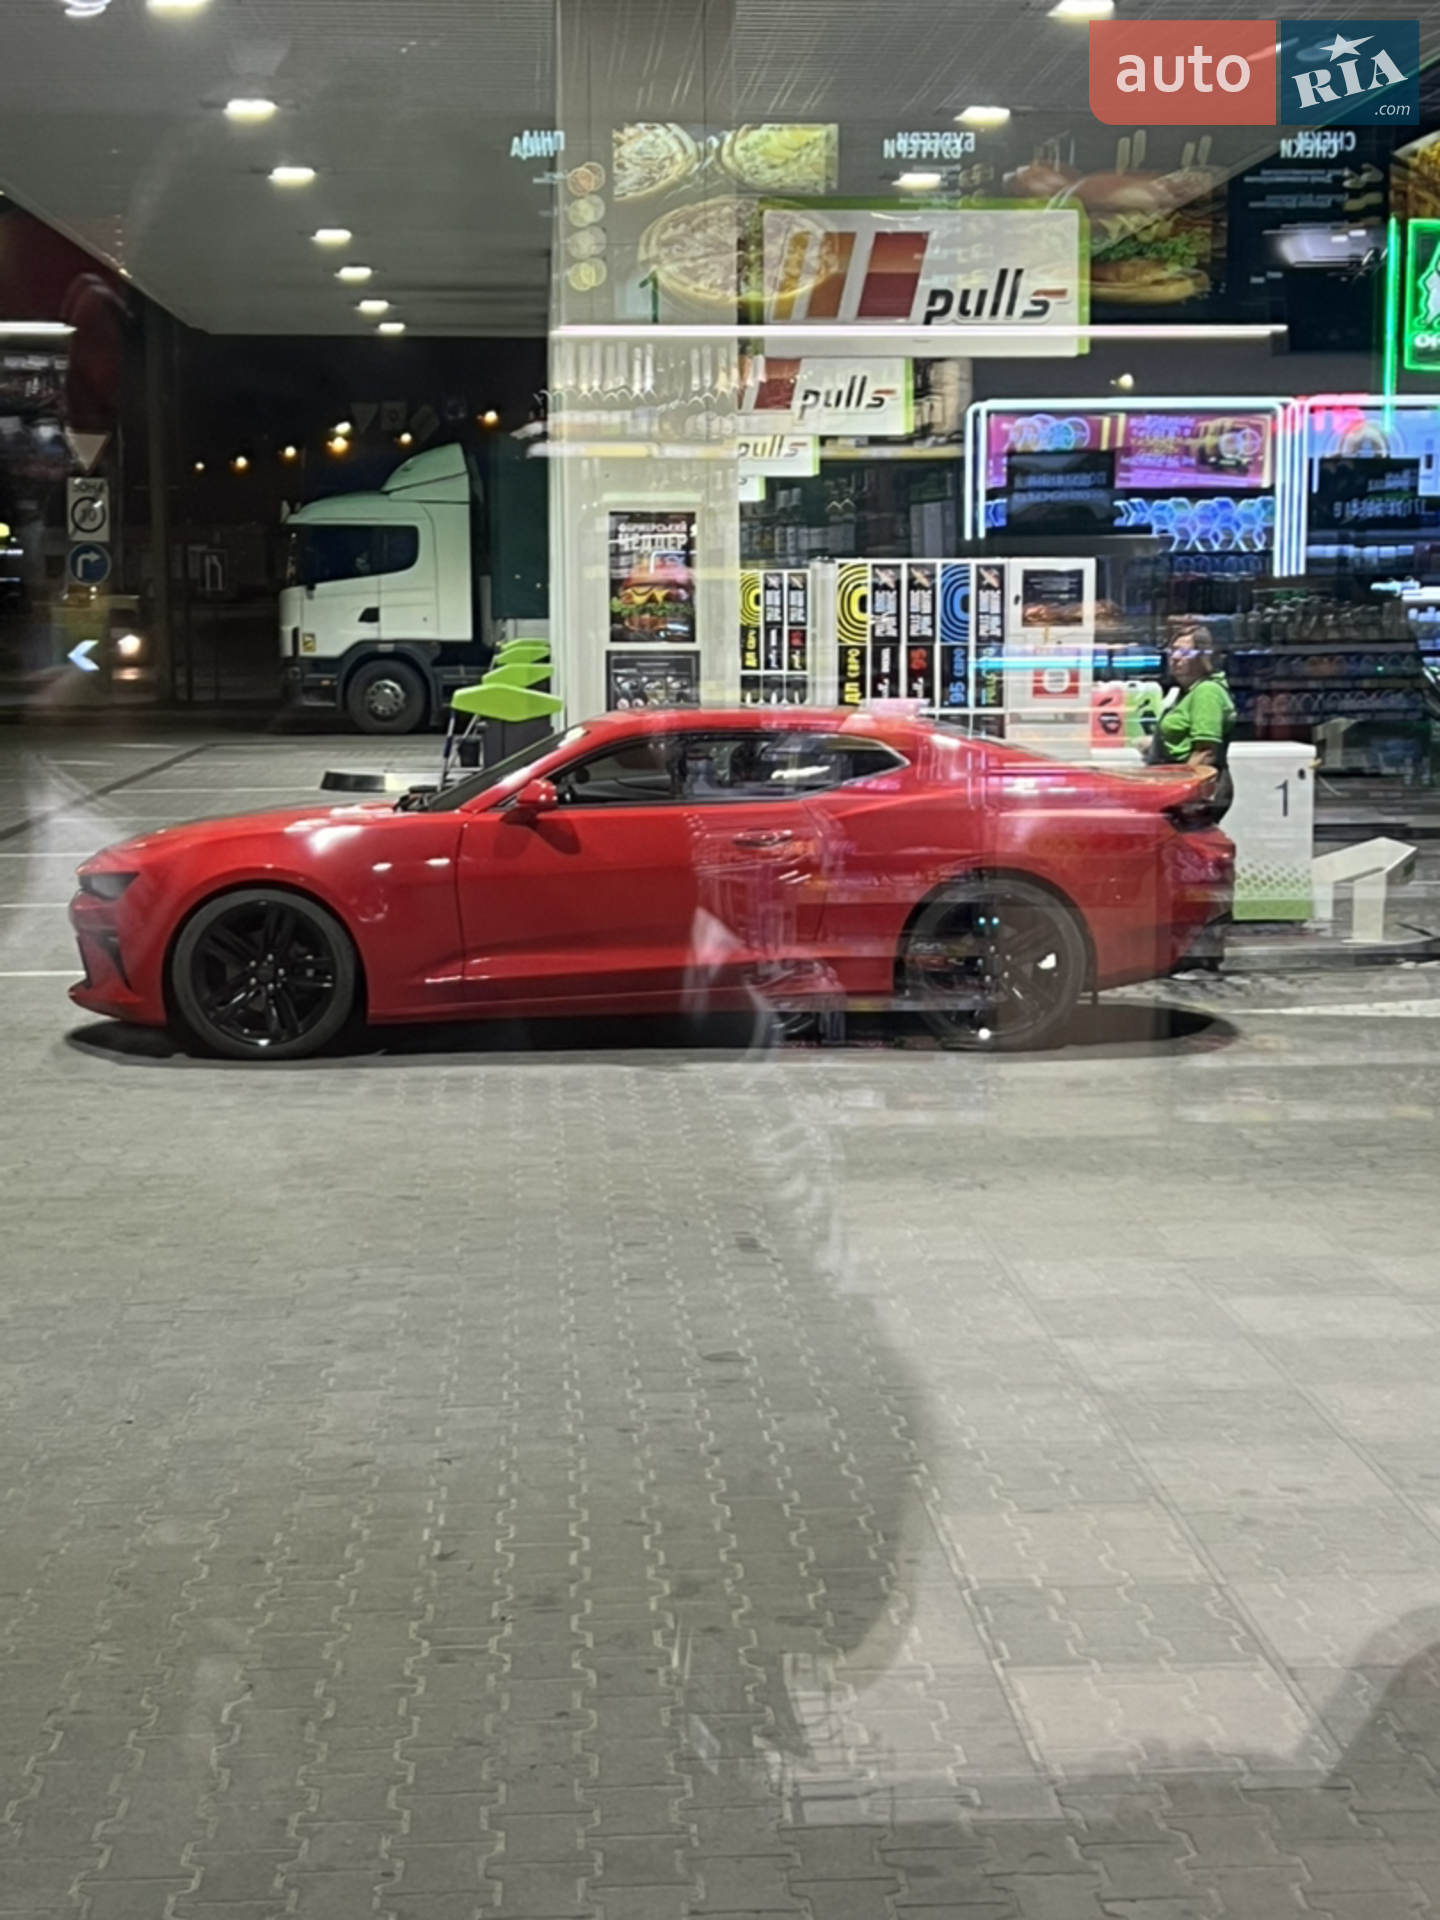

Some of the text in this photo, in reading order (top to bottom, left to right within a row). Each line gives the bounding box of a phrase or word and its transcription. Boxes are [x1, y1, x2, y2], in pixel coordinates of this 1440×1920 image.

[923, 268, 1068, 326] pulls
[799, 375, 897, 421] pulls
[910, 649, 927, 670] 95
[844, 682, 861, 704] ДП
[948, 682, 965, 704] 95
[1275, 780, 1288, 816] 1
